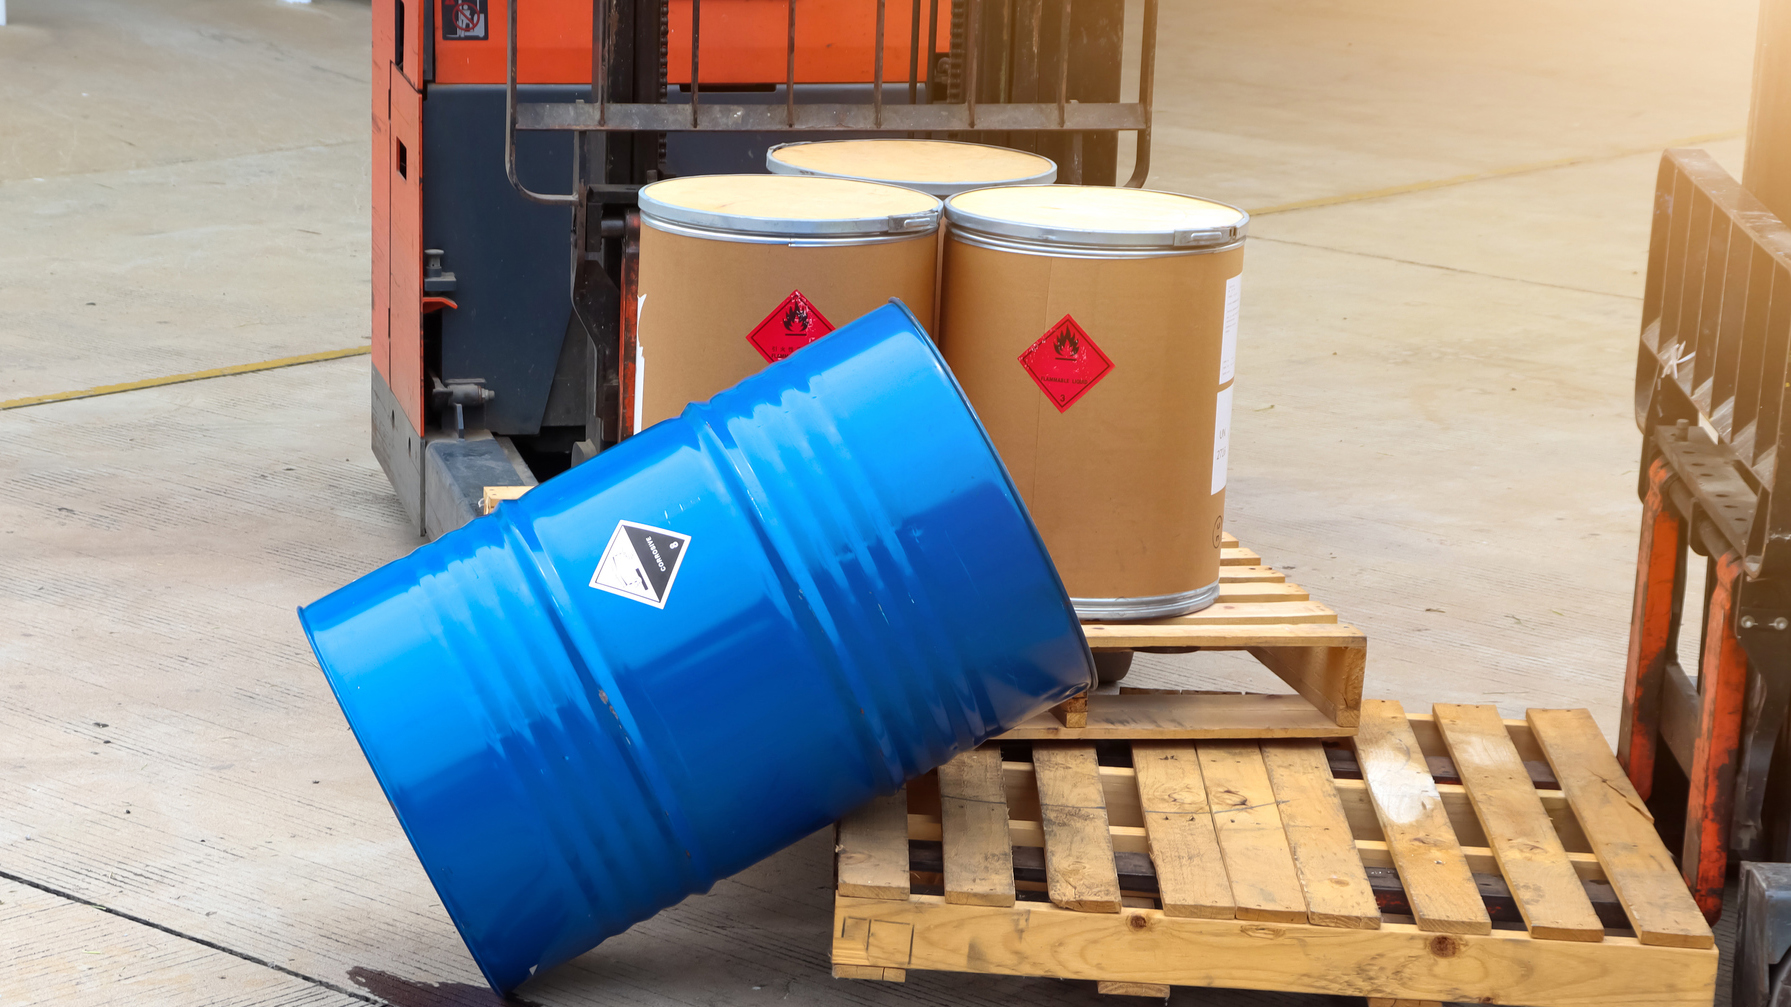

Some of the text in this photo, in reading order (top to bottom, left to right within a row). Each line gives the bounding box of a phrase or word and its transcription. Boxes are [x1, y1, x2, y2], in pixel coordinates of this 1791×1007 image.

[1060, 394, 1066, 402] 3
[669, 541, 679, 549] 8
[645, 535, 667, 572] CORROSIVE
